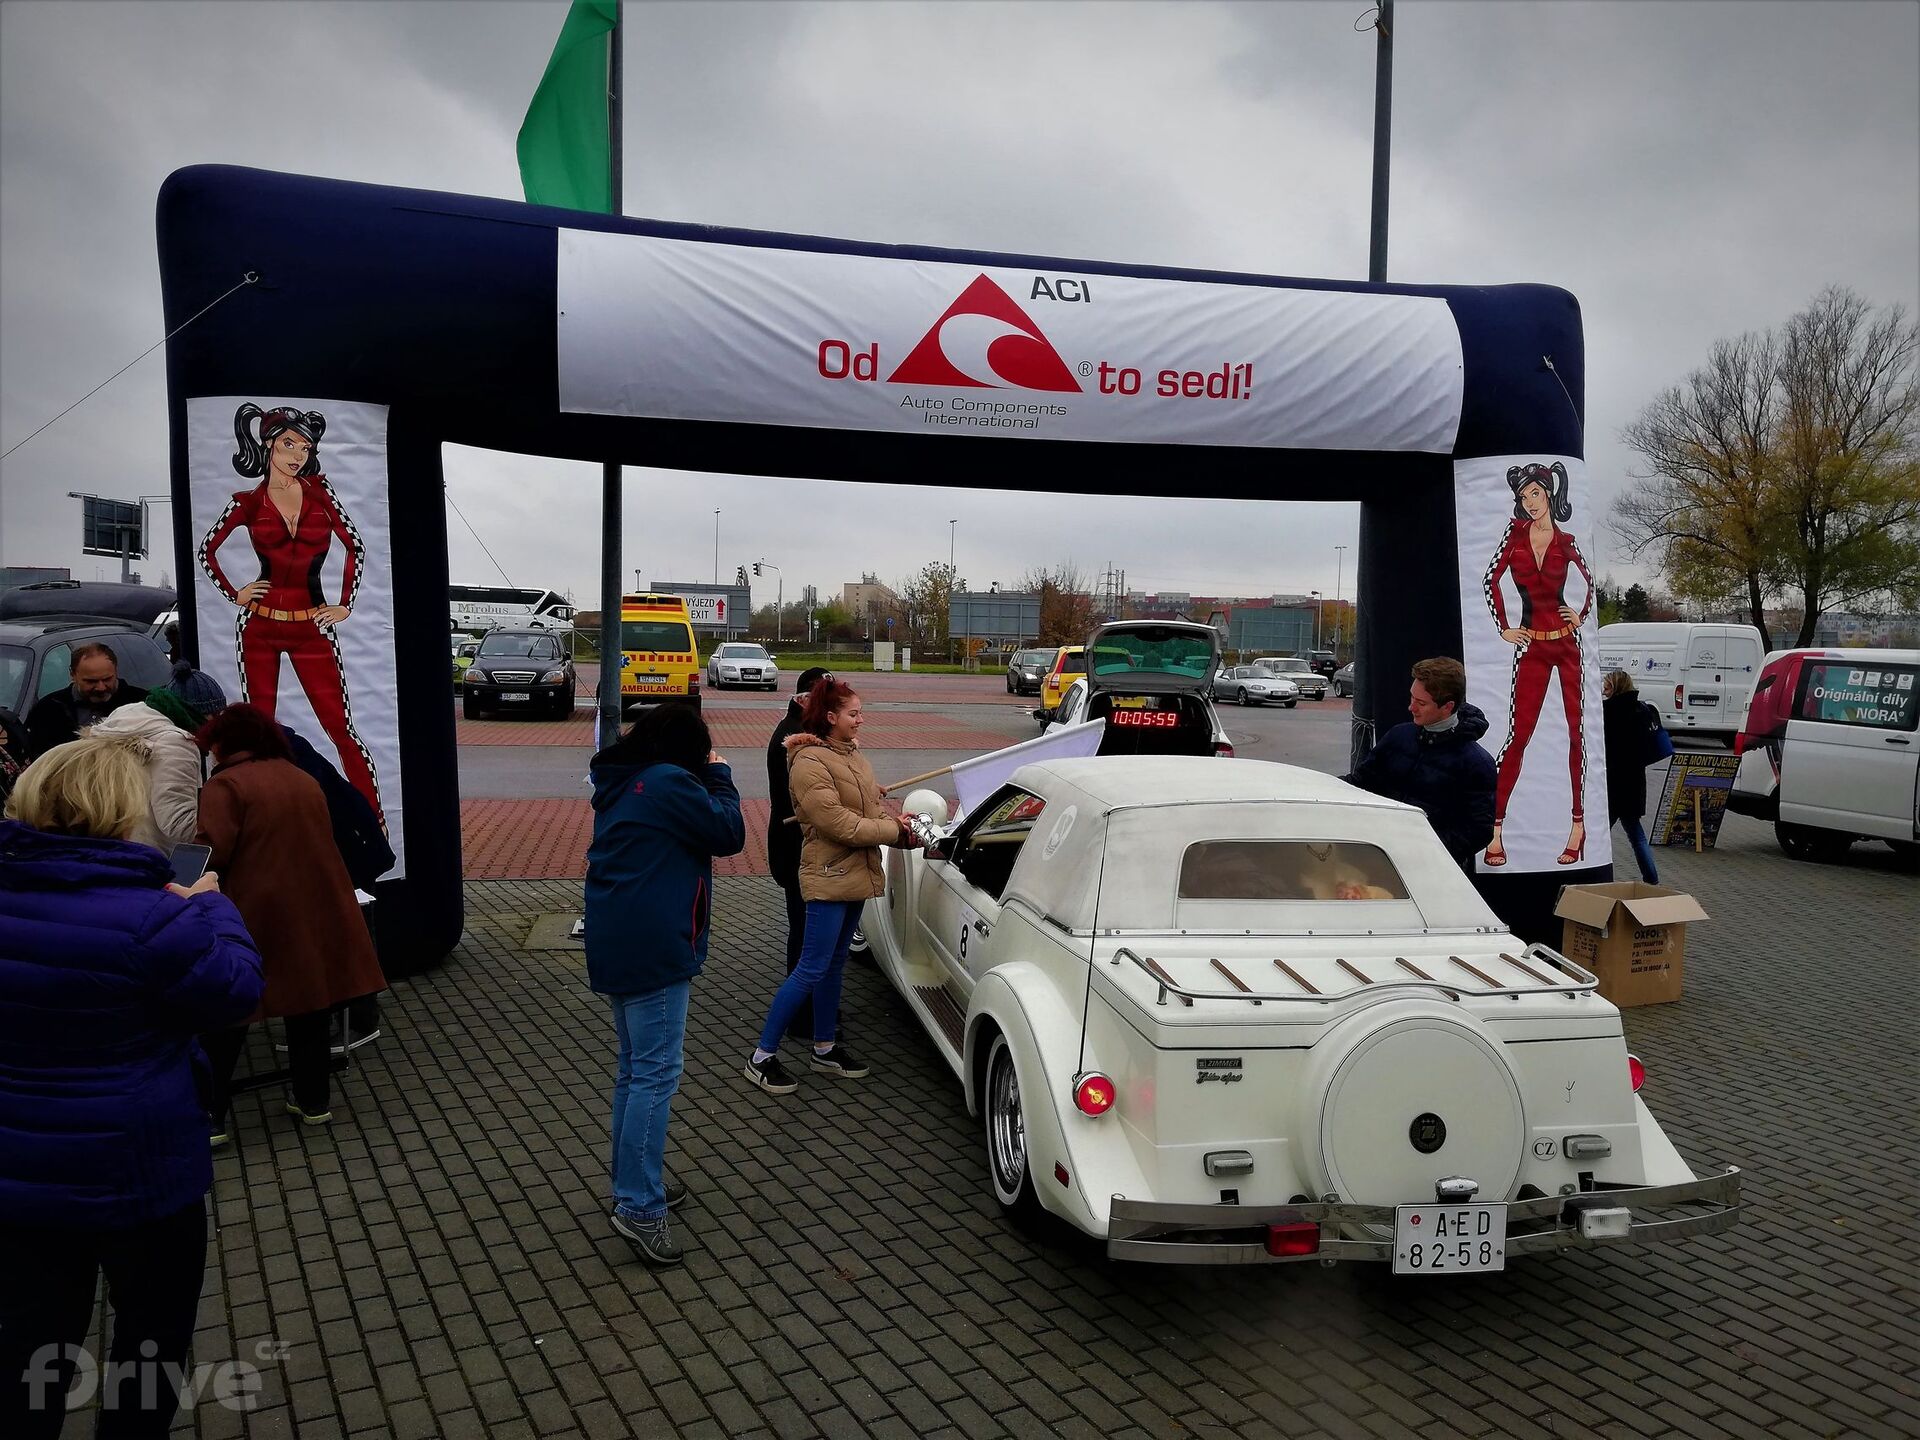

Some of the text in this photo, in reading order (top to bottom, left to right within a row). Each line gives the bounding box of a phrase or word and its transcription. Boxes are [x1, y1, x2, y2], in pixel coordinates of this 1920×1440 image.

[1030, 276, 1092, 303] ACI
[818, 339, 878, 382] Od
[1098, 362, 1141, 395] to
[1156, 362, 1253, 400] sedí!
[900, 395, 1067, 416] Auto Components
[923, 411, 1039, 429] International
[457, 603, 509, 614] Mirobus
[691, 610, 709, 620] EXIT
[621, 685, 683, 693] AMBULANCE
[1813, 686, 1909, 708] Originální díly
[1113, 711, 1176, 726] 10:05:59
[1672, 754, 1740, 768] ZDE MONTUJEME
[960, 923, 969, 959] 8
[1534, 1141, 1557, 1158] CZ
[1408, 1241, 1493, 1268] 82-58
